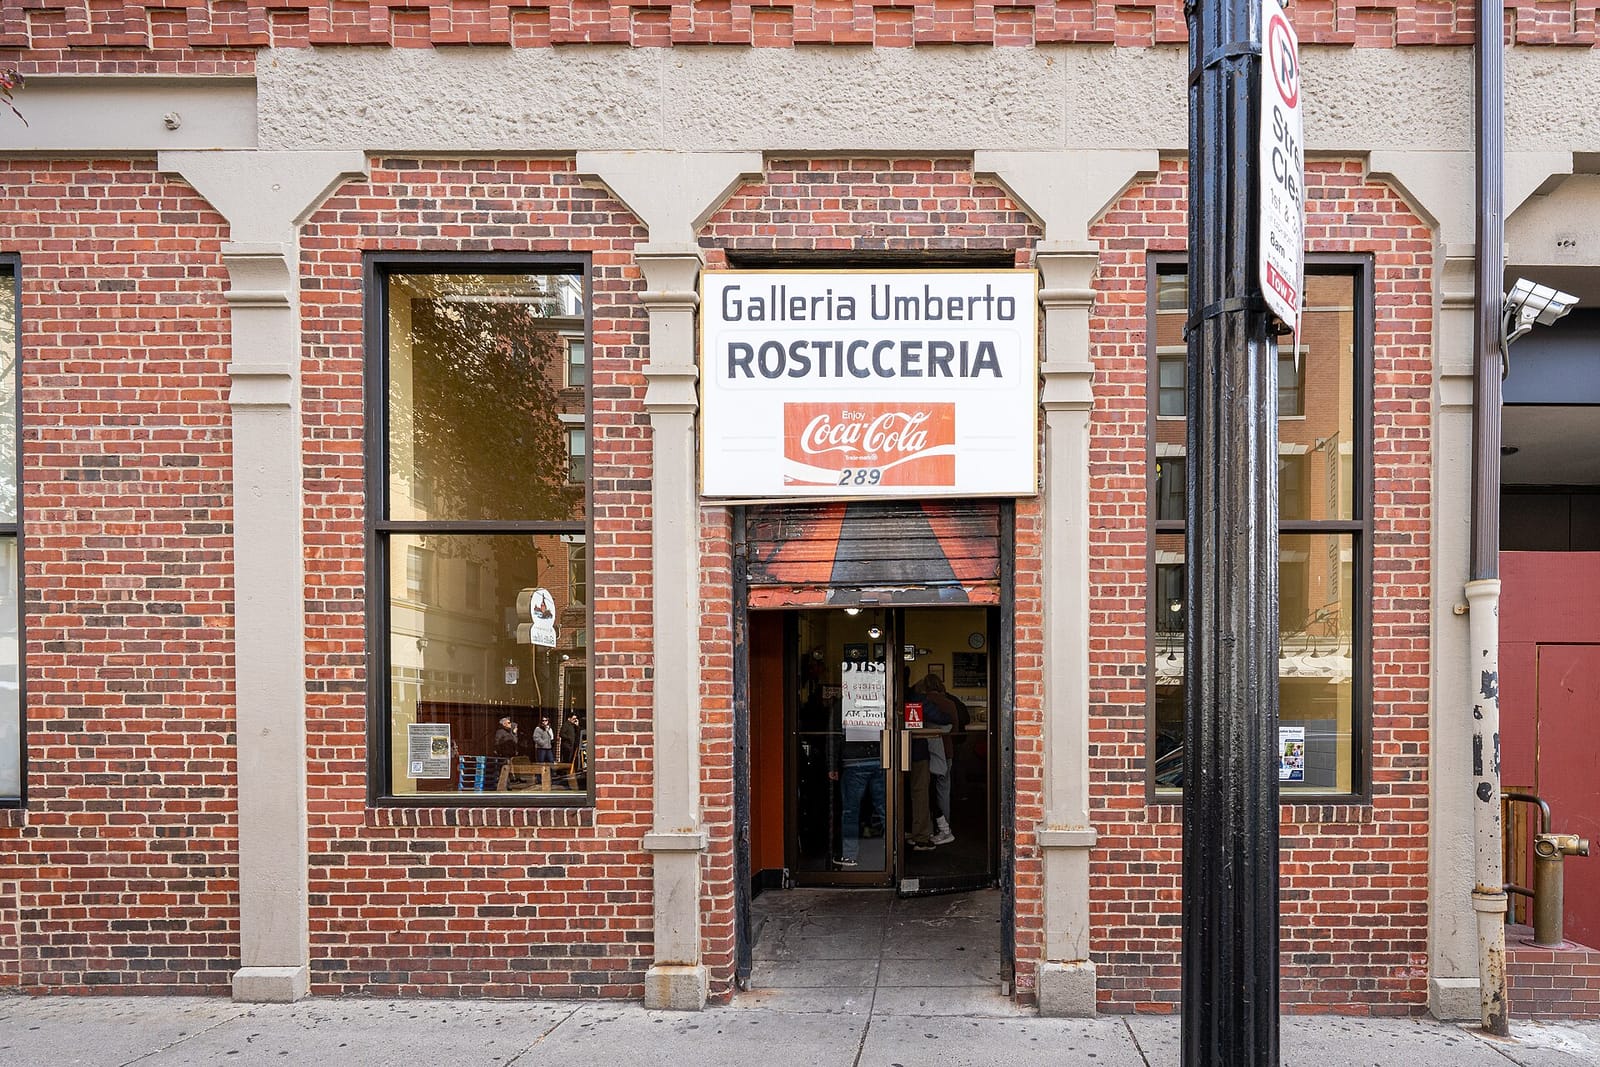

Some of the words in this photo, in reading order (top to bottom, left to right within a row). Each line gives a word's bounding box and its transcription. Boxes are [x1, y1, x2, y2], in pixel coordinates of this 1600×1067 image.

[1270, 187, 1281, 213] 1st
[1270, 231, 1286, 259] 8am
[722, 284, 856, 322] Galleria
[870, 284, 1016, 321] Umberto
[728, 339, 1003, 379] ROSTICCERIA
[841, 410, 866, 420] Enjoy
[800, 410, 932, 455] Coca-Cola
[838, 468, 881, 486] 289
